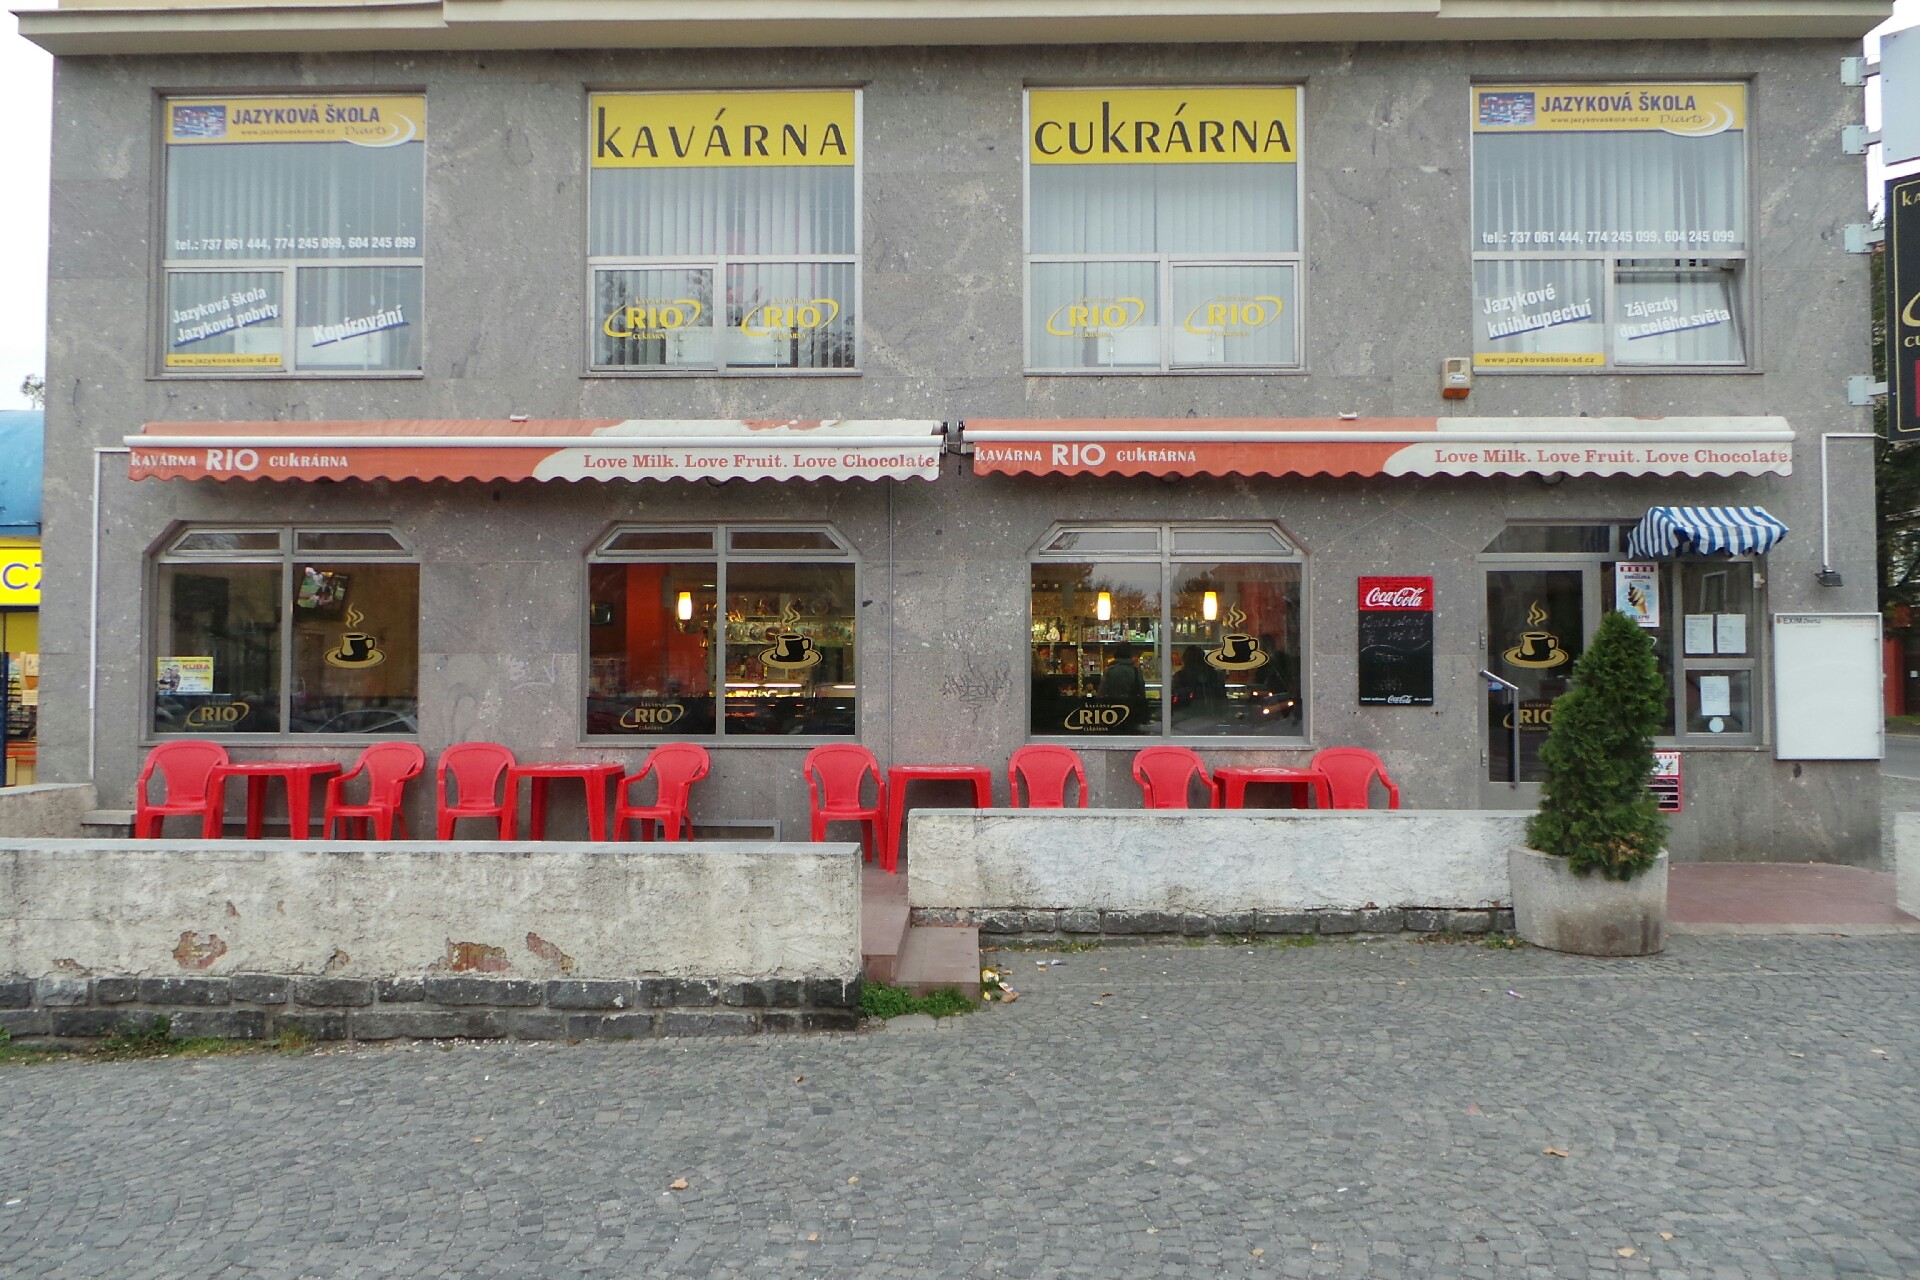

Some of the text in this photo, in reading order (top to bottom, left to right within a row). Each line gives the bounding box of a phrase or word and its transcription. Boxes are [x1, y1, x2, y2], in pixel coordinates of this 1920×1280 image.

[1541, 91, 1696, 113] JAZYKOVÁ ŠKOLA
[232, 104, 380, 125] JAZYKOVÁ ŠKOLA
[175, 239, 199, 251] tel.:
[202, 238, 222, 250] 737
[224, 238, 244, 250] 061
[274, 238, 295, 249] 774
[298, 237, 319, 249] 245
[348, 237, 369, 249] 604
[371, 237, 393, 249] 245
[395, 236, 416, 248] 099
[1482, 232, 1507, 243] tel.:
[1510, 232, 1531, 243] 737
[1534, 232, 1554, 243] 061
[1587, 231, 1608, 243] 774
[1611, 231, 1633, 243] 245
[1664, 231, 1686, 242] 604
[1688, 231, 1710, 242] 245
[1713, 230, 1735, 242] 099
[172, 288, 267, 324] Jazyková škola
[1482, 283, 1556, 315] Jazykové
[1624, 296, 1679, 318] Zájezdy
[312, 304, 404, 345] Kopírování
[626, 306, 684, 329] RIO
[763, 305, 821, 329] RIO
[1069, 305, 1128, 328] RIO
[1207, 303, 1265, 326] RIO
[1486, 298, 1592, 338] knihkupectví
[1619, 308, 1731, 339] do celého světa
[177, 313, 235, 342] Jazykové
[206, 448, 259, 471] RIO
[584, 453, 940, 468] Love Milk. Love Fruit. Love Chocolate.
[1052, 443, 1105, 466] RIO
[1435, 449, 1792, 463] Love Milk. Love Fruit. Love Chocolate.
[201, 706, 238, 721] RIO
[635, 708, 673, 723] RIO
[1080, 709, 1118, 725] RIO
